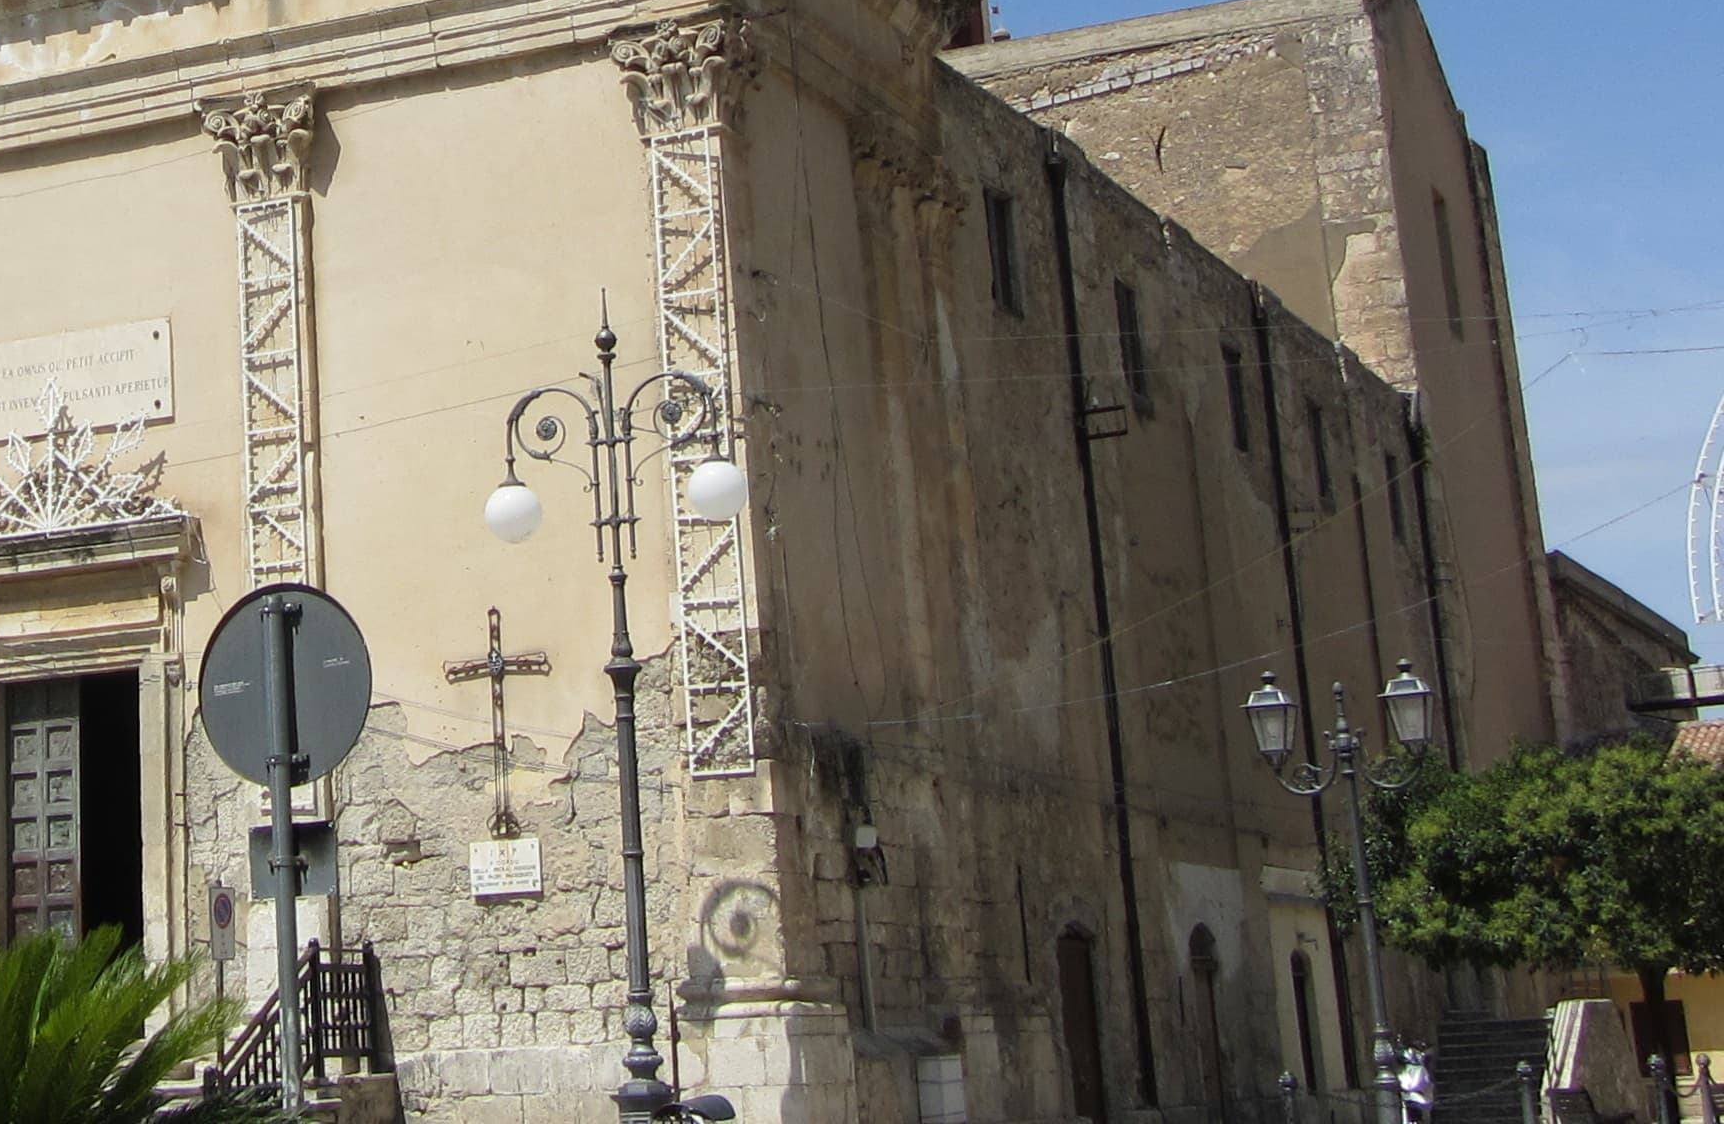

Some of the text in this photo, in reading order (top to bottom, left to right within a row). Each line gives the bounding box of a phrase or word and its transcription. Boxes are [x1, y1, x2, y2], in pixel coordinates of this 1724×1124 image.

[66, 356, 94, 371] PETIT
[99, 349, 135, 365] ACCIPIT
[62, 385, 112, 404] PULSANTI
